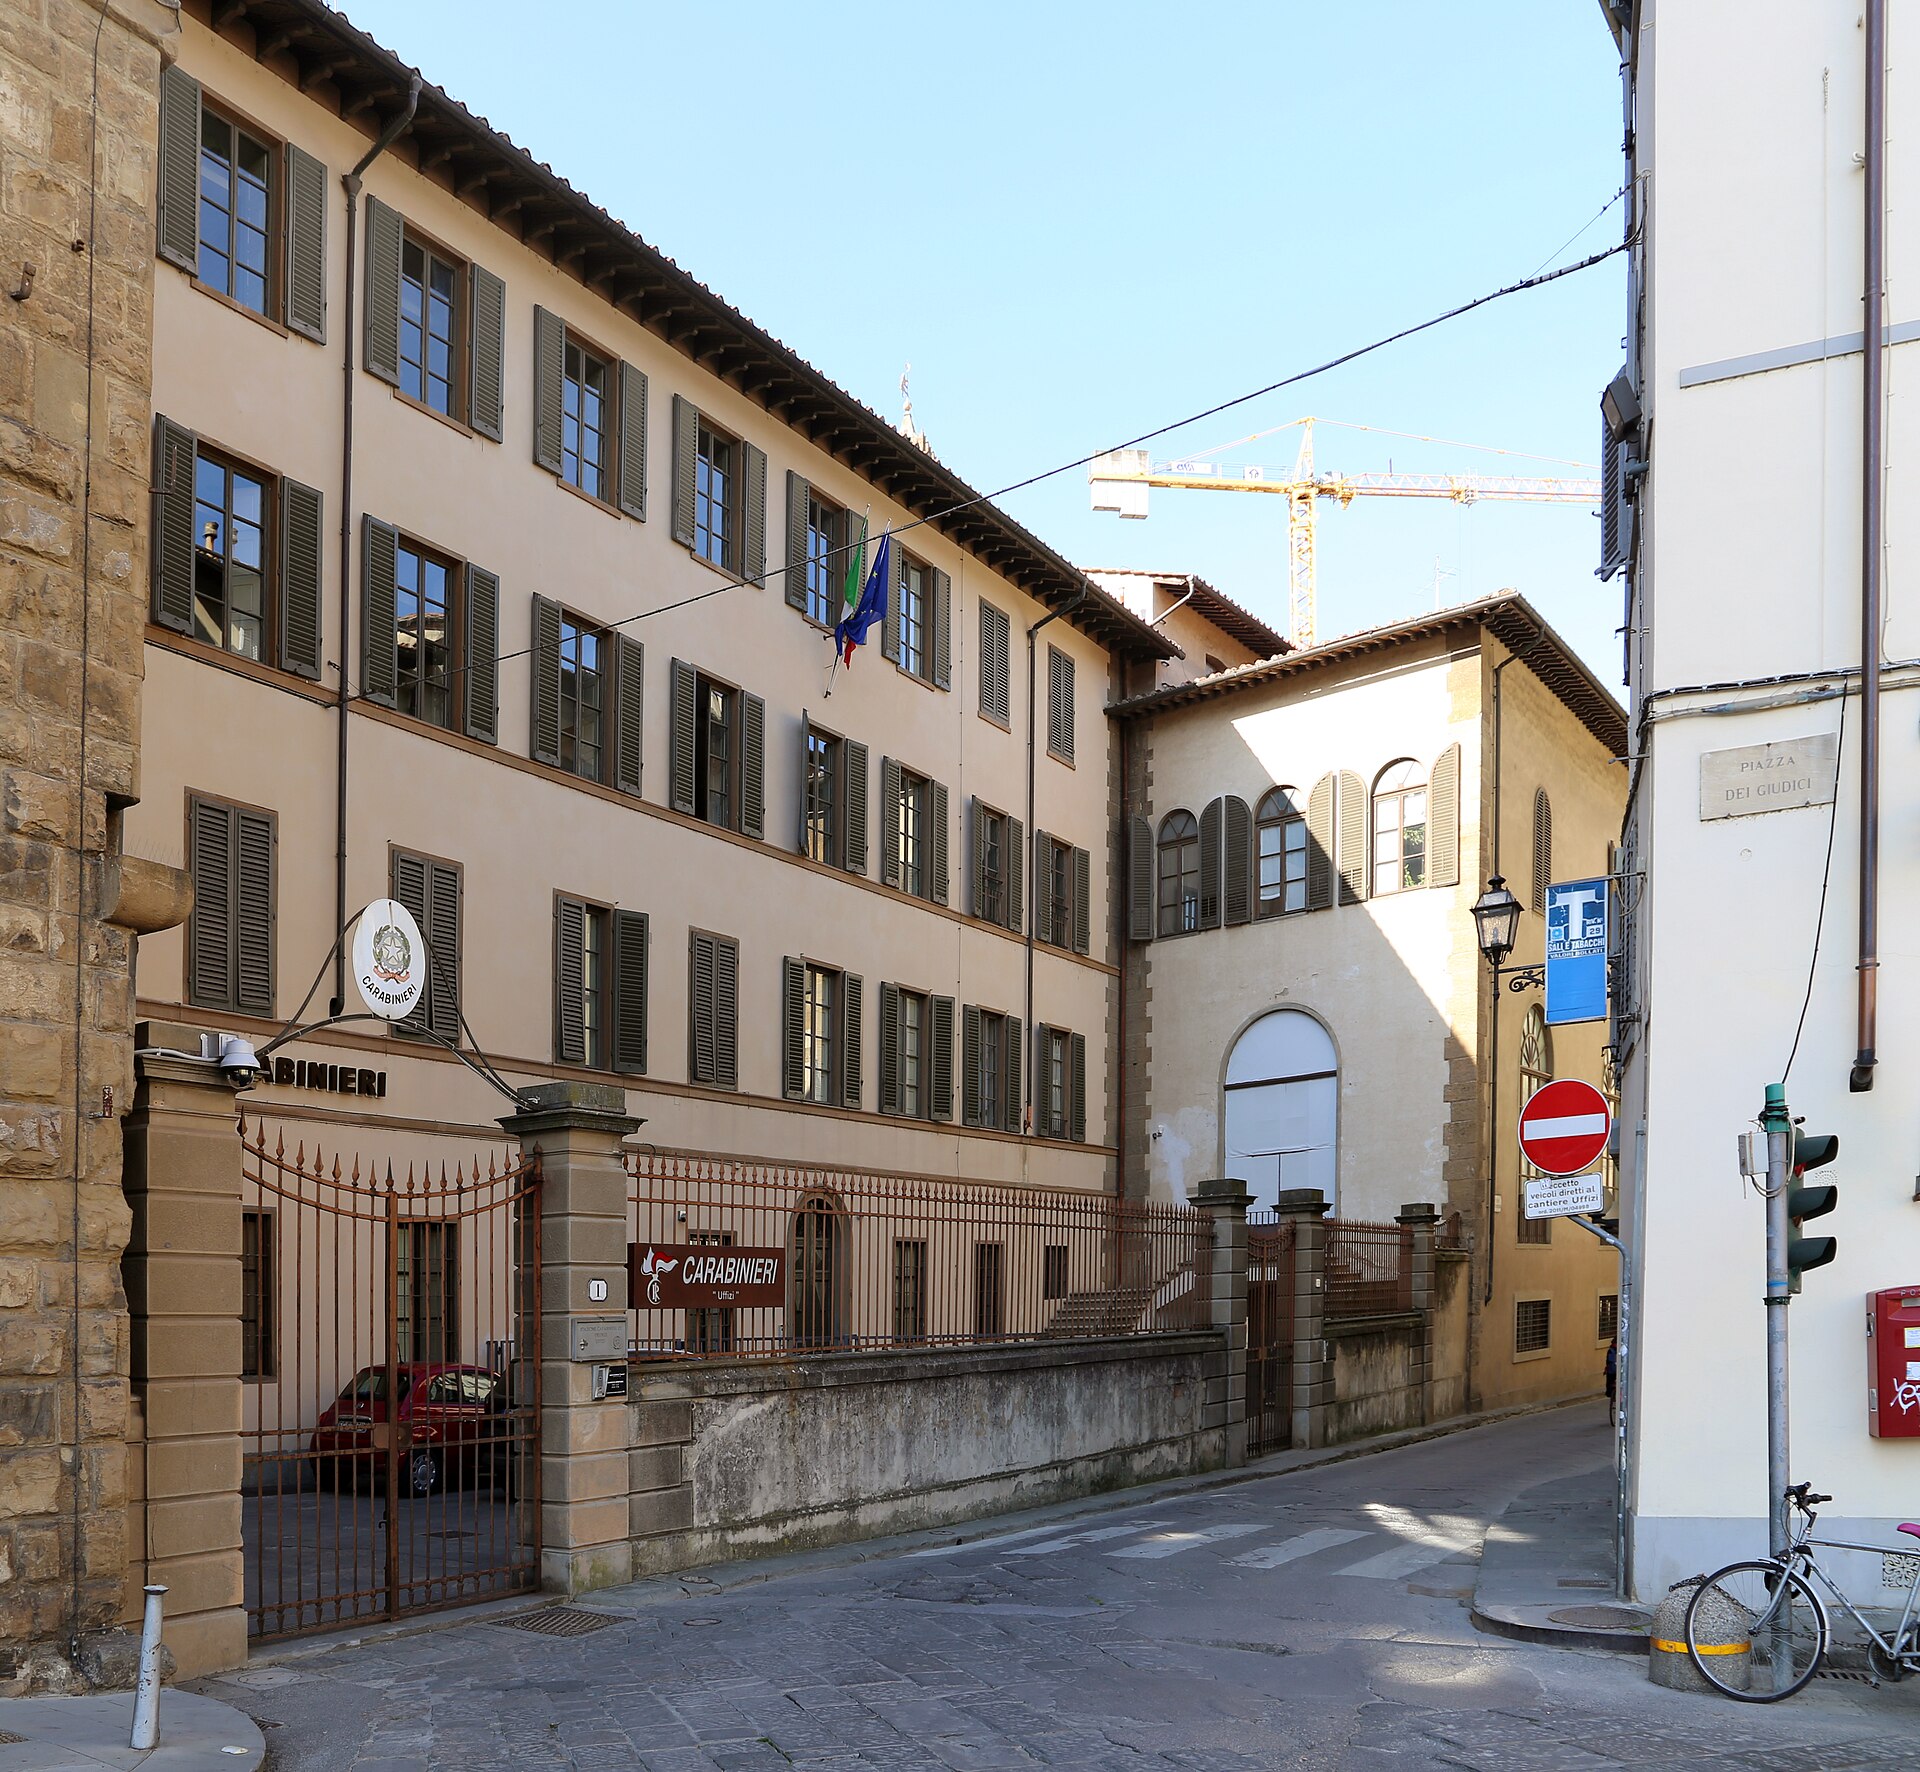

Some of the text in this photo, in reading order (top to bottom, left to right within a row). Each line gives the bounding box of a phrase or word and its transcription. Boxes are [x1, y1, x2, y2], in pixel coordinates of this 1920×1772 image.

[1740, 756, 1796, 772] PIAZZA
[1725, 778, 1811, 801] DEI GIUDICI
[1556, 889, 1596, 939] T
[1589, 927, 1601, 935] 29
[1548, 938, 1605, 952] SALI E TABACCHI
[362, 975, 417, 1004] CARABINIERI
[1530, 1186, 1595, 1200] veicoli diretti al
[1528, 1194, 1599, 1209] cantiere Uffizi
[682, 1255, 779, 1285] CARABINIERI
[1901, 1288, 1920, 1296] PO
